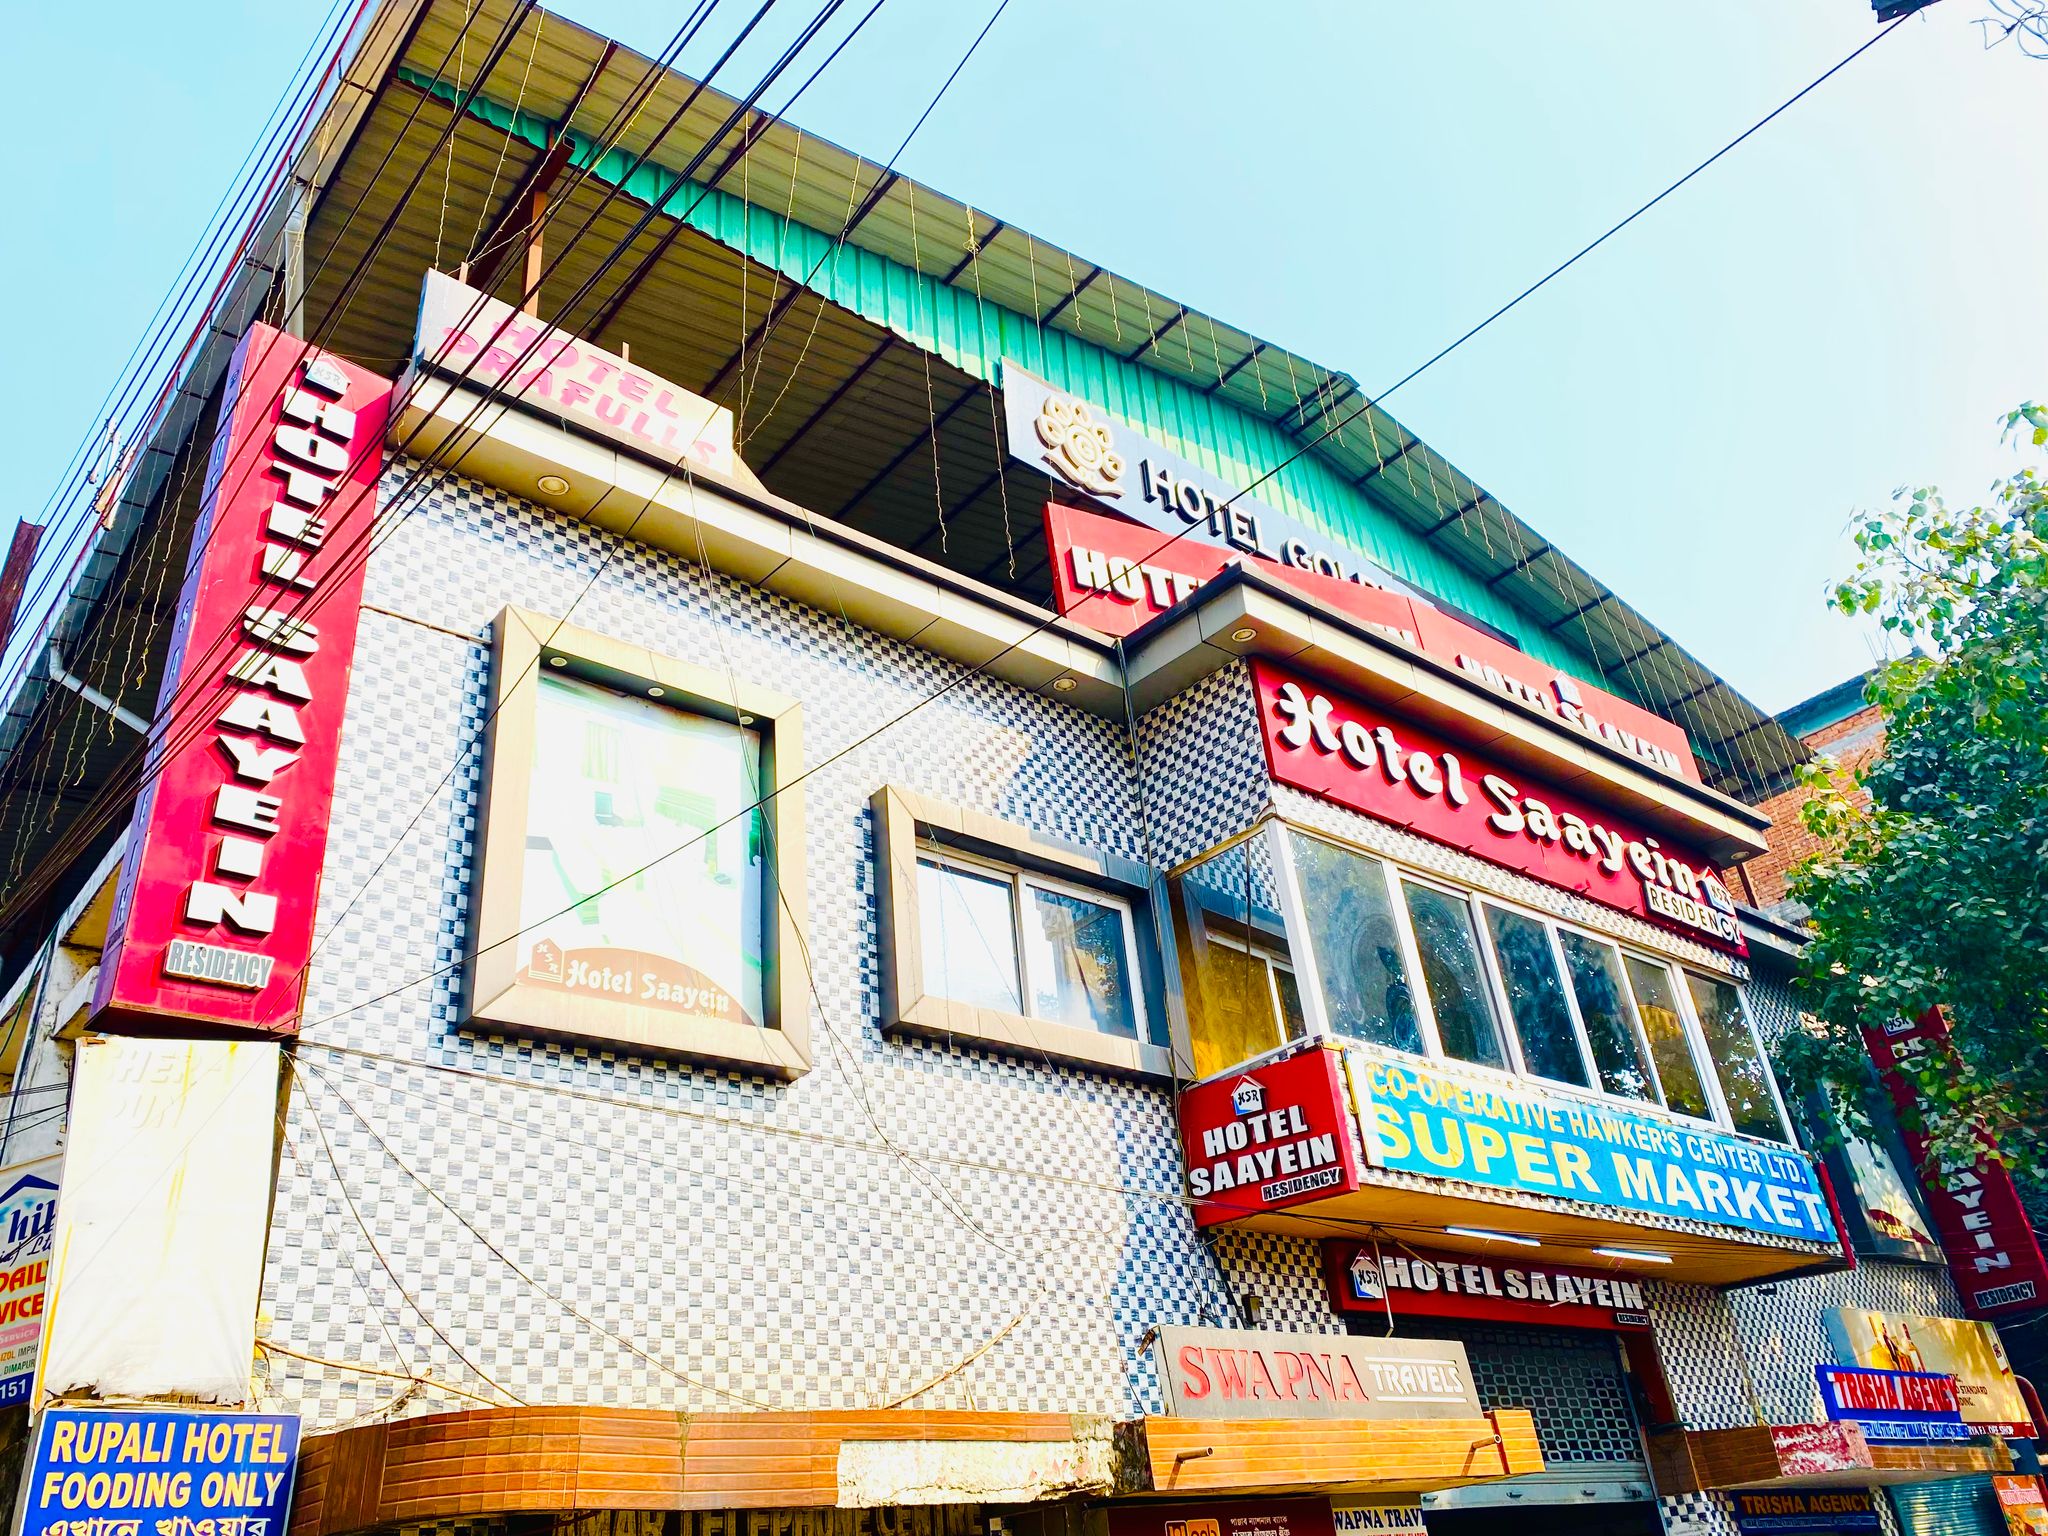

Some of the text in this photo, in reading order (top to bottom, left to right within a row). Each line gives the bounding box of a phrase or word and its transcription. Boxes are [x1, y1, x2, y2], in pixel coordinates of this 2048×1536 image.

[491, 318, 679, 419] HOTEL
[1141, 458, 1281, 563] HOTEL
[1072, 545, 1208, 609] HOTE
[187, 386, 356, 933] HOTEL SAAYEIN
[1276, 682, 1703, 899] Hotel Saayein
[1649, 886, 1740, 942] RESIDENCY
[166, 941, 273, 988] RESIDENCY
[565, 959, 730, 1012] Hotel Saayein
[1202, 1104, 1309, 1158] HOTEL
[1364, 1062, 1807, 1185] CO-OPERATIVE HAWKER'S CENTER LTD.
[1189, 1132, 1337, 1197] SAAYEIN
[1263, 1168, 1341, 1201] RESIDENCY
[1374, 1103, 1825, 1233] SUPER MARKET
[1382, 1255, 1645, 1311] HOTEL SAAYEIN
[1975, 1282, 2036, 1308] RESIDENCY
[1178, 1345, 1465, 1403] SWAPNA TRAVELS
[1833, 1372, 1961, 1412] TRISHA AGENCY
[49, 1420, 288, 1464] RUPALI HOTEL
[39, 1471, 285, 1509] FOODING ONLY
[1741, 1495, 1871, 1514] TRISHA AGENCY
